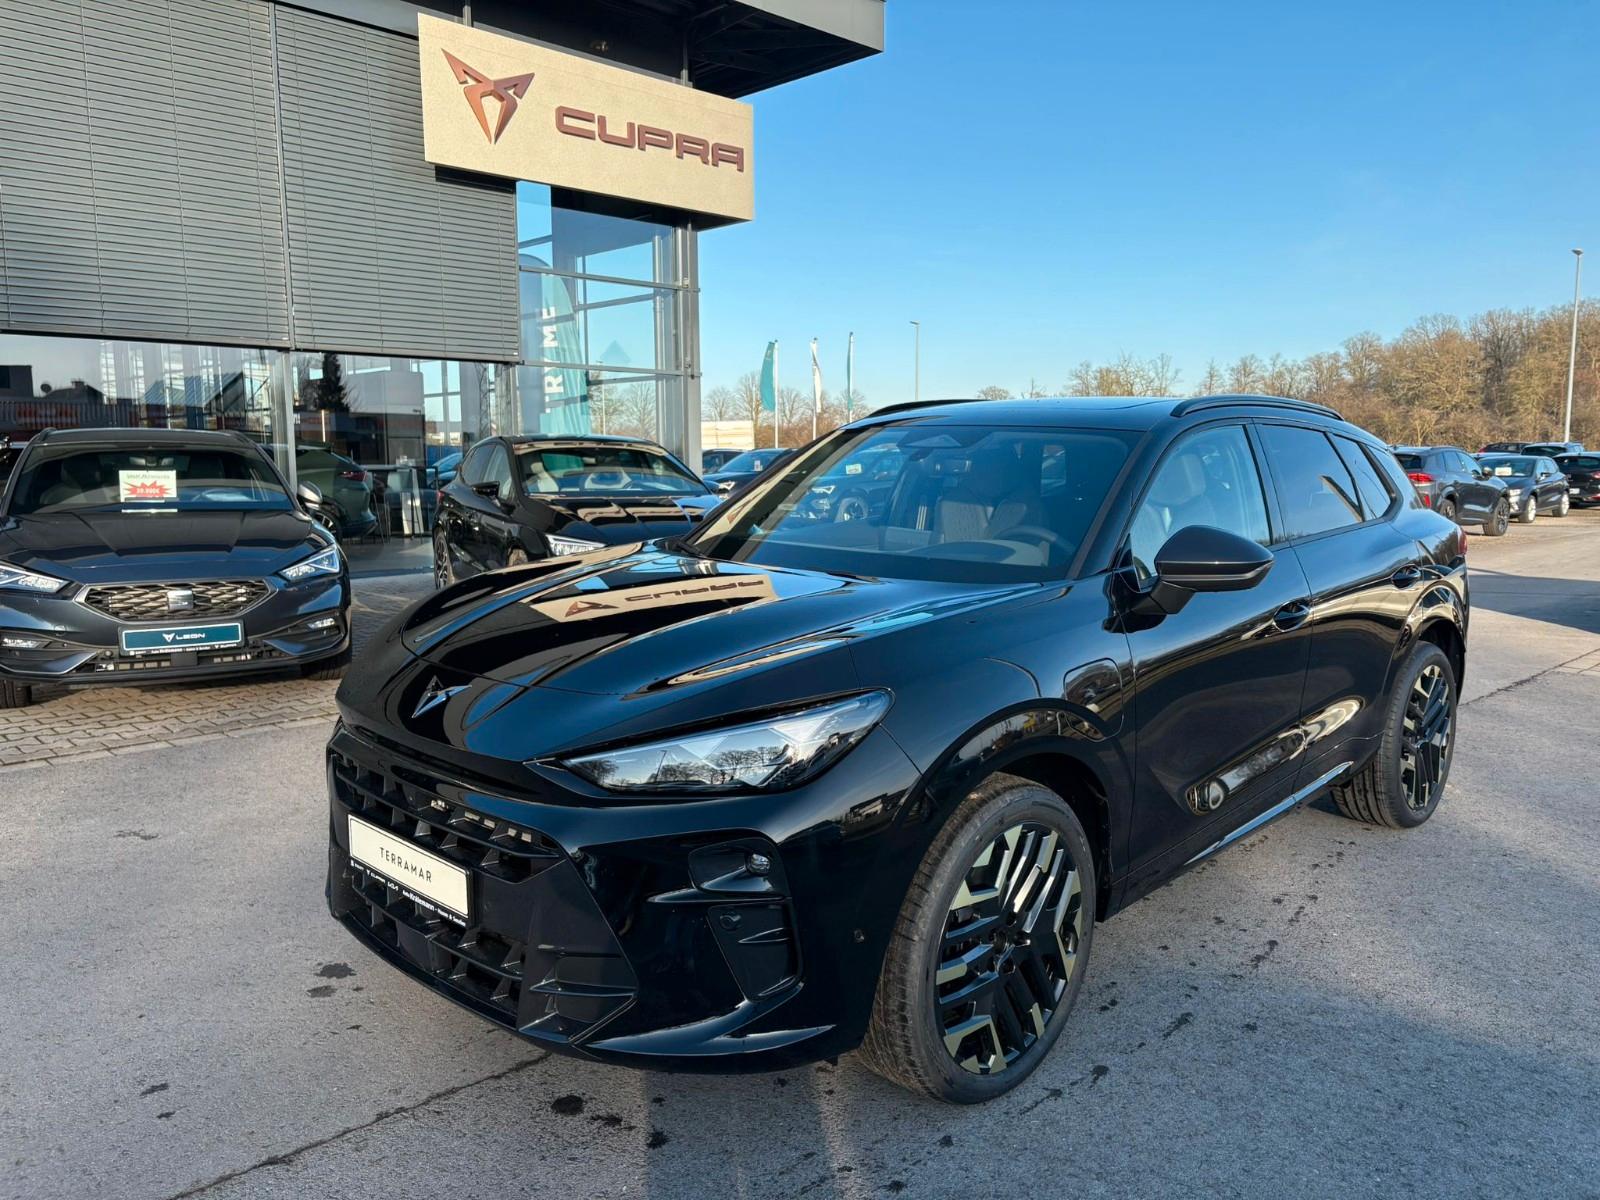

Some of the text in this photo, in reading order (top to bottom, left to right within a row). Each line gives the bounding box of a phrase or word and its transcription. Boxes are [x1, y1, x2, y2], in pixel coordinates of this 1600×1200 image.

[555, 105, 744, 173] CUPRA
[175, 633, 206, 641] LEON
[379, 846, 432, 883] TERRAMAR
